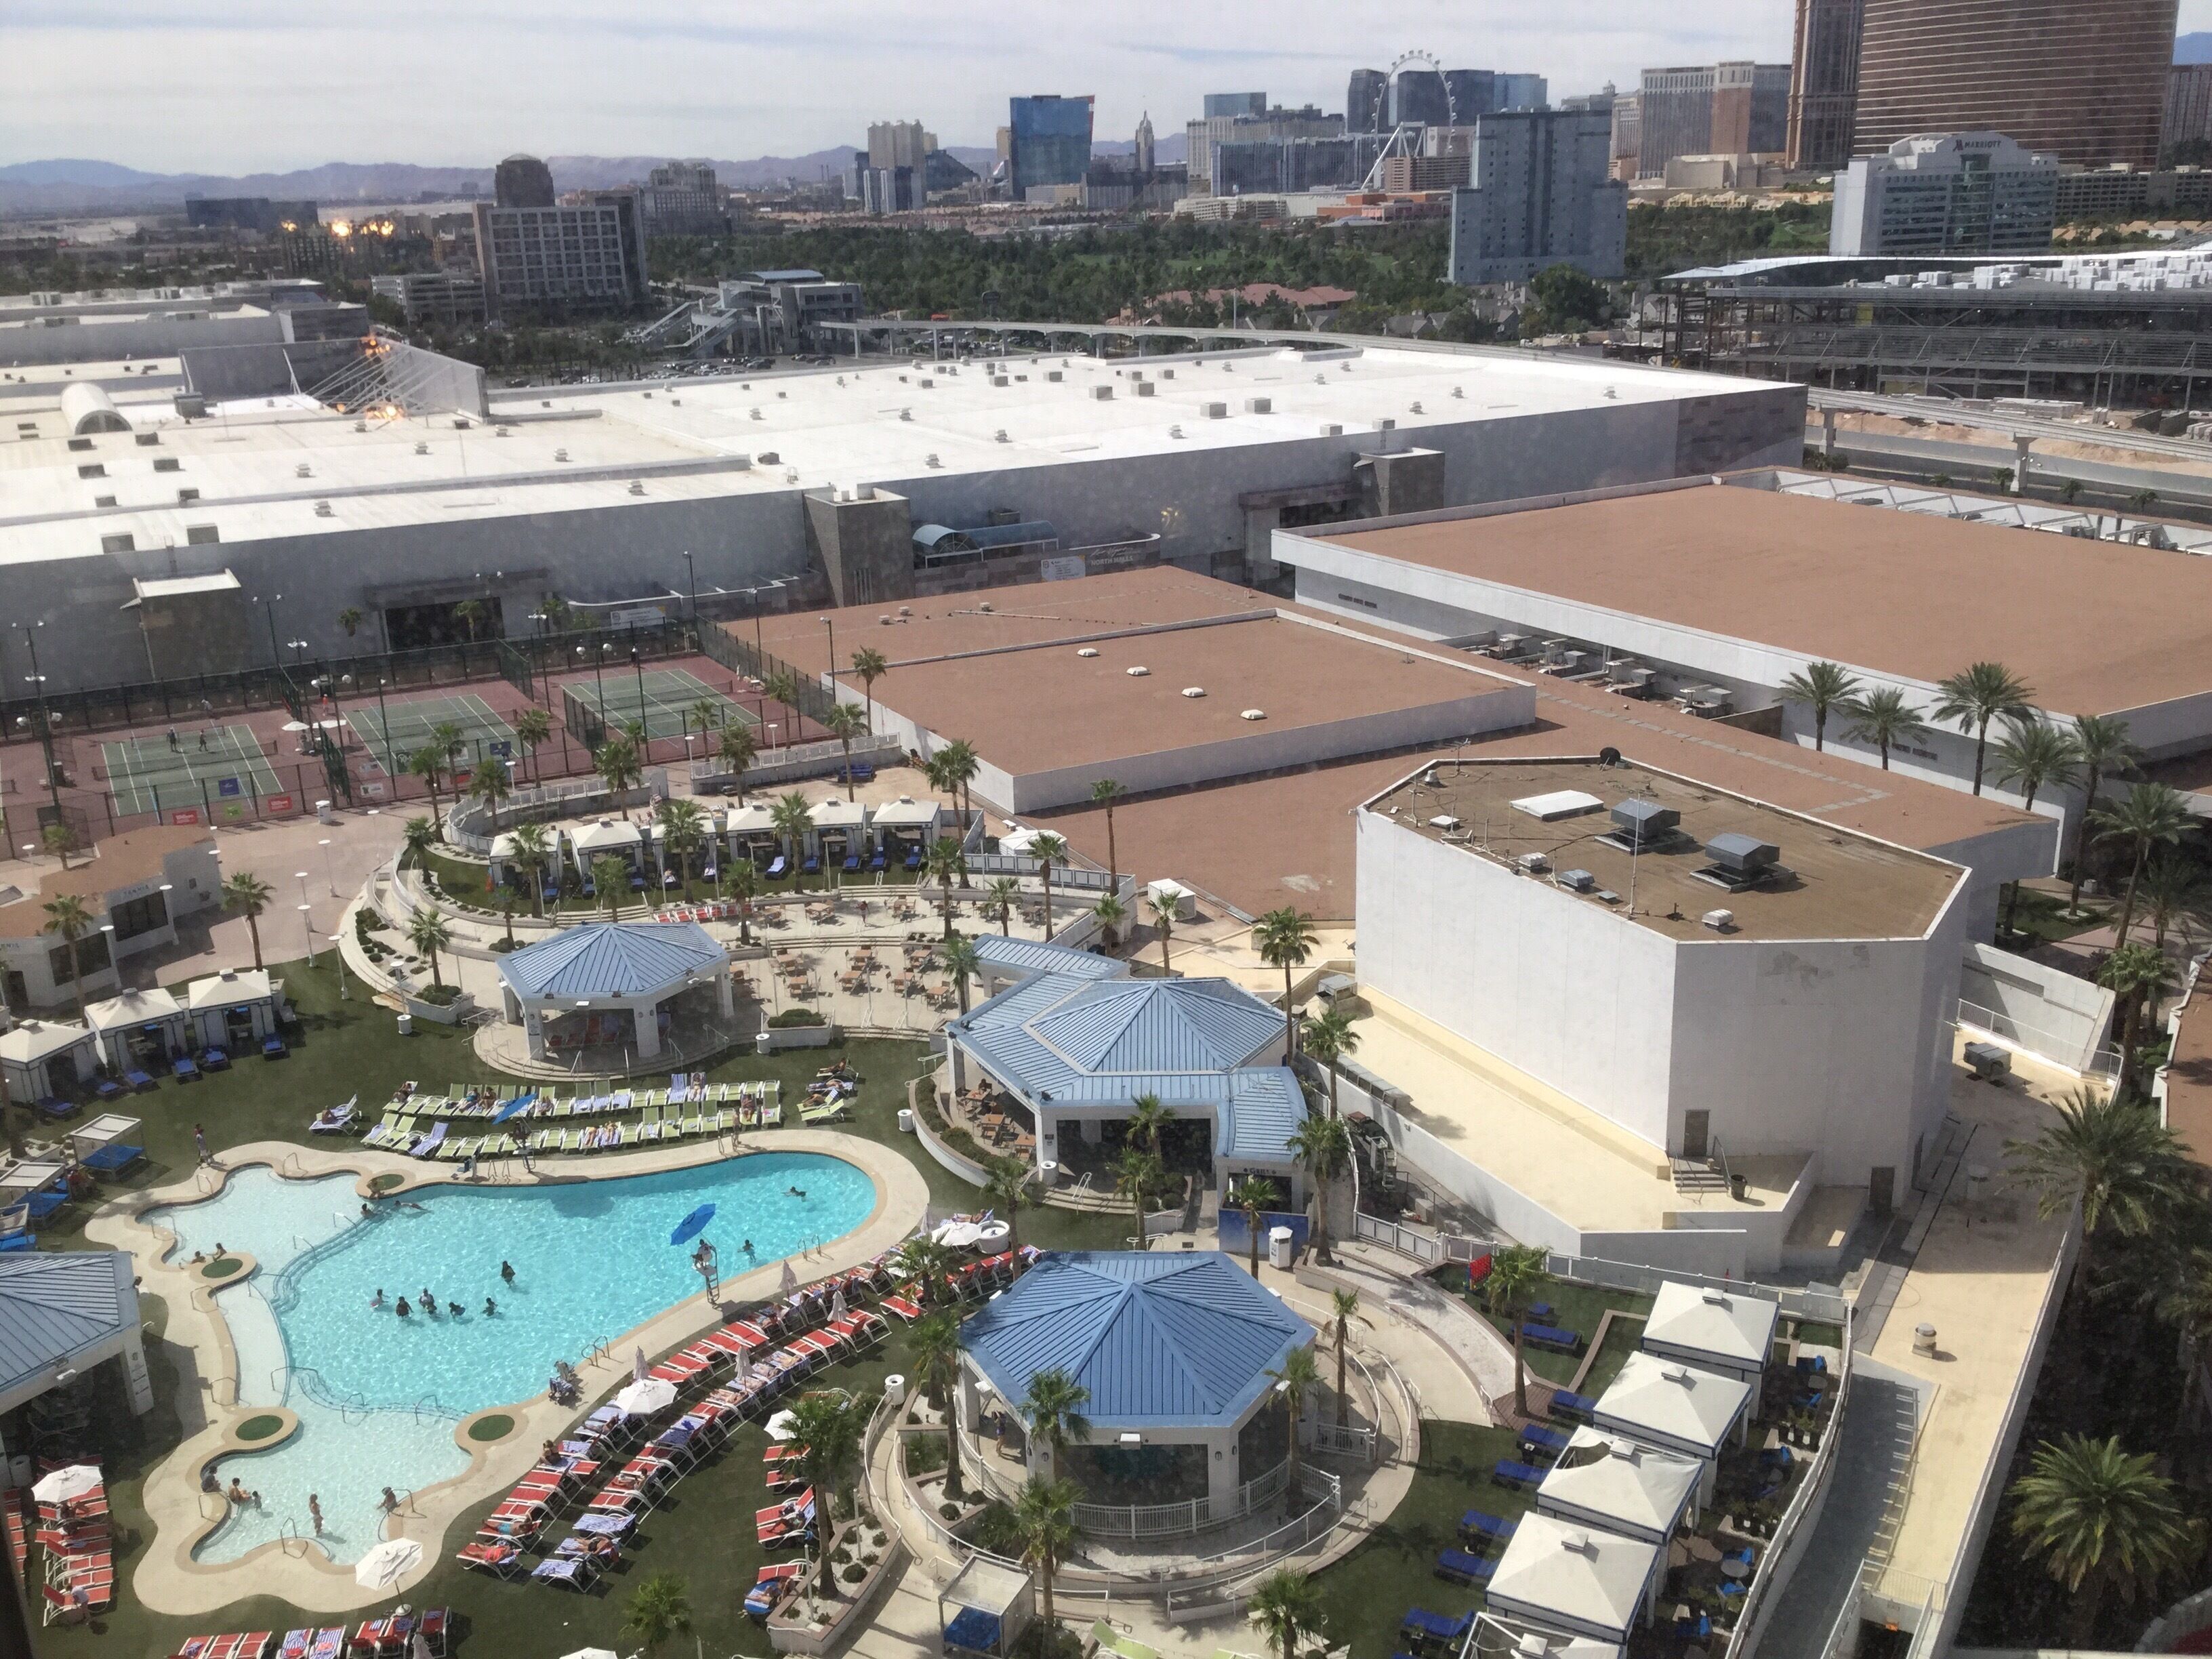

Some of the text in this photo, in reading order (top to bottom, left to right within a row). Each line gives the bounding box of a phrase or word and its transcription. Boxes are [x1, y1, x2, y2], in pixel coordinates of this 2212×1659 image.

[1965, 140, 2001, 148] MARRIOTT
[1090, 555, 1134, 566] NORTH HALLS
[1249, 1167, 1269, 1175] GRILL
